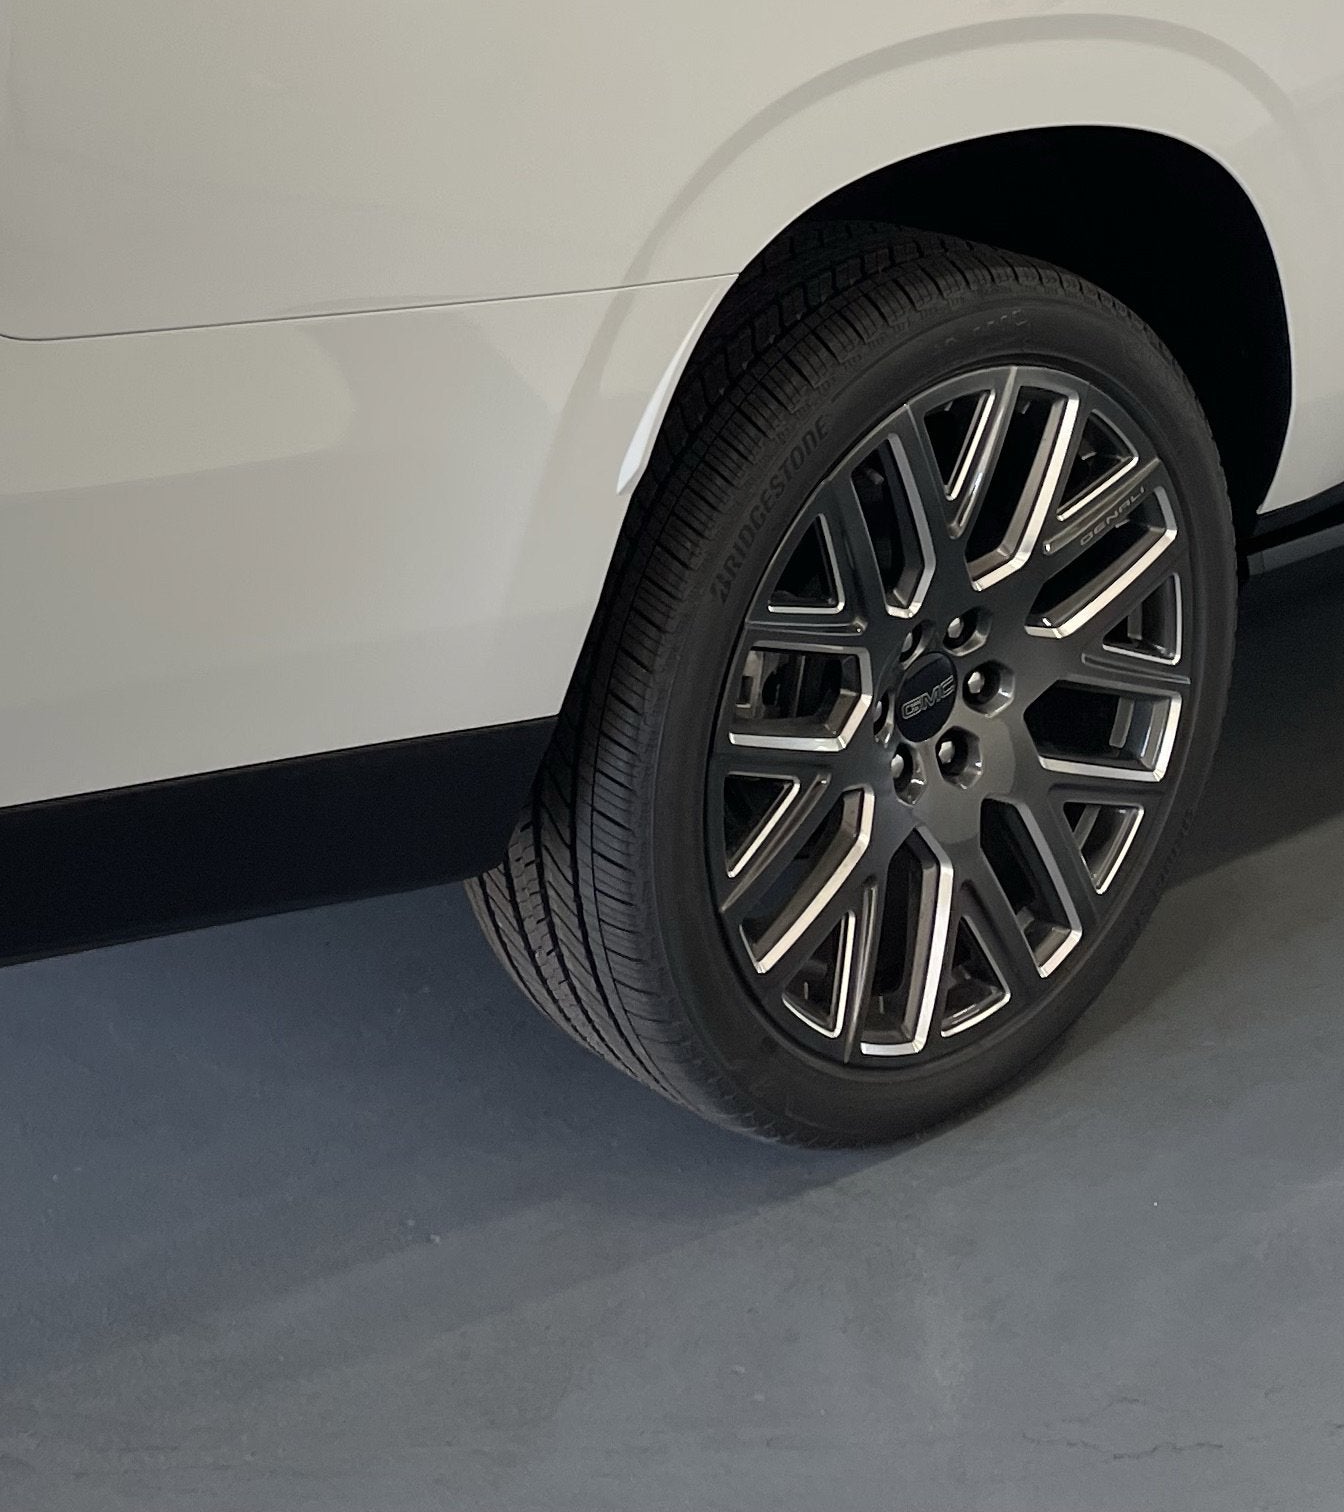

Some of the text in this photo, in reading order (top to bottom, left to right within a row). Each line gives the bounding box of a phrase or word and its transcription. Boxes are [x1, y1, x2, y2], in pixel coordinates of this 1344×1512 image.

[711, 414, 830, 605] BRIDGESTONE
[1080, 485, 1145, 546] DENALI
[900, 675, 956, 719] GMC
